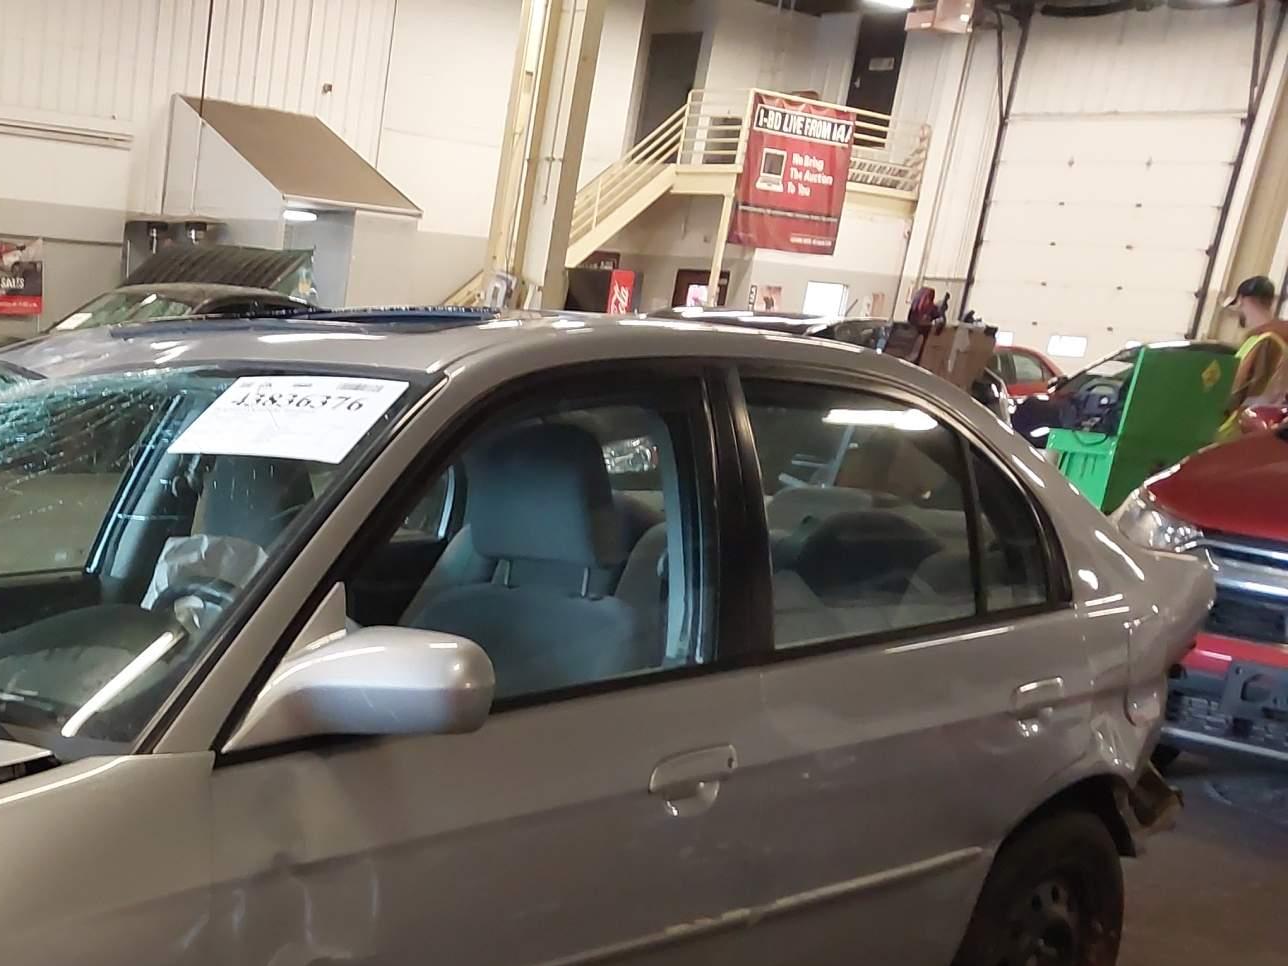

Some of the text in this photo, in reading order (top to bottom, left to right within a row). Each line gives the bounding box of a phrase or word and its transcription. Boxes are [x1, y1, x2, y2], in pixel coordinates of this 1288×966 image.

[782, 112, 804, 135] LIVE
[804, 117, 831, 140] FROM
[789, 167, 834, 186] The Auction
[787, 181, 811, 198] To You
[0, 276, 26, 290] SALES
[231, 391, 366, 412] 43836376
